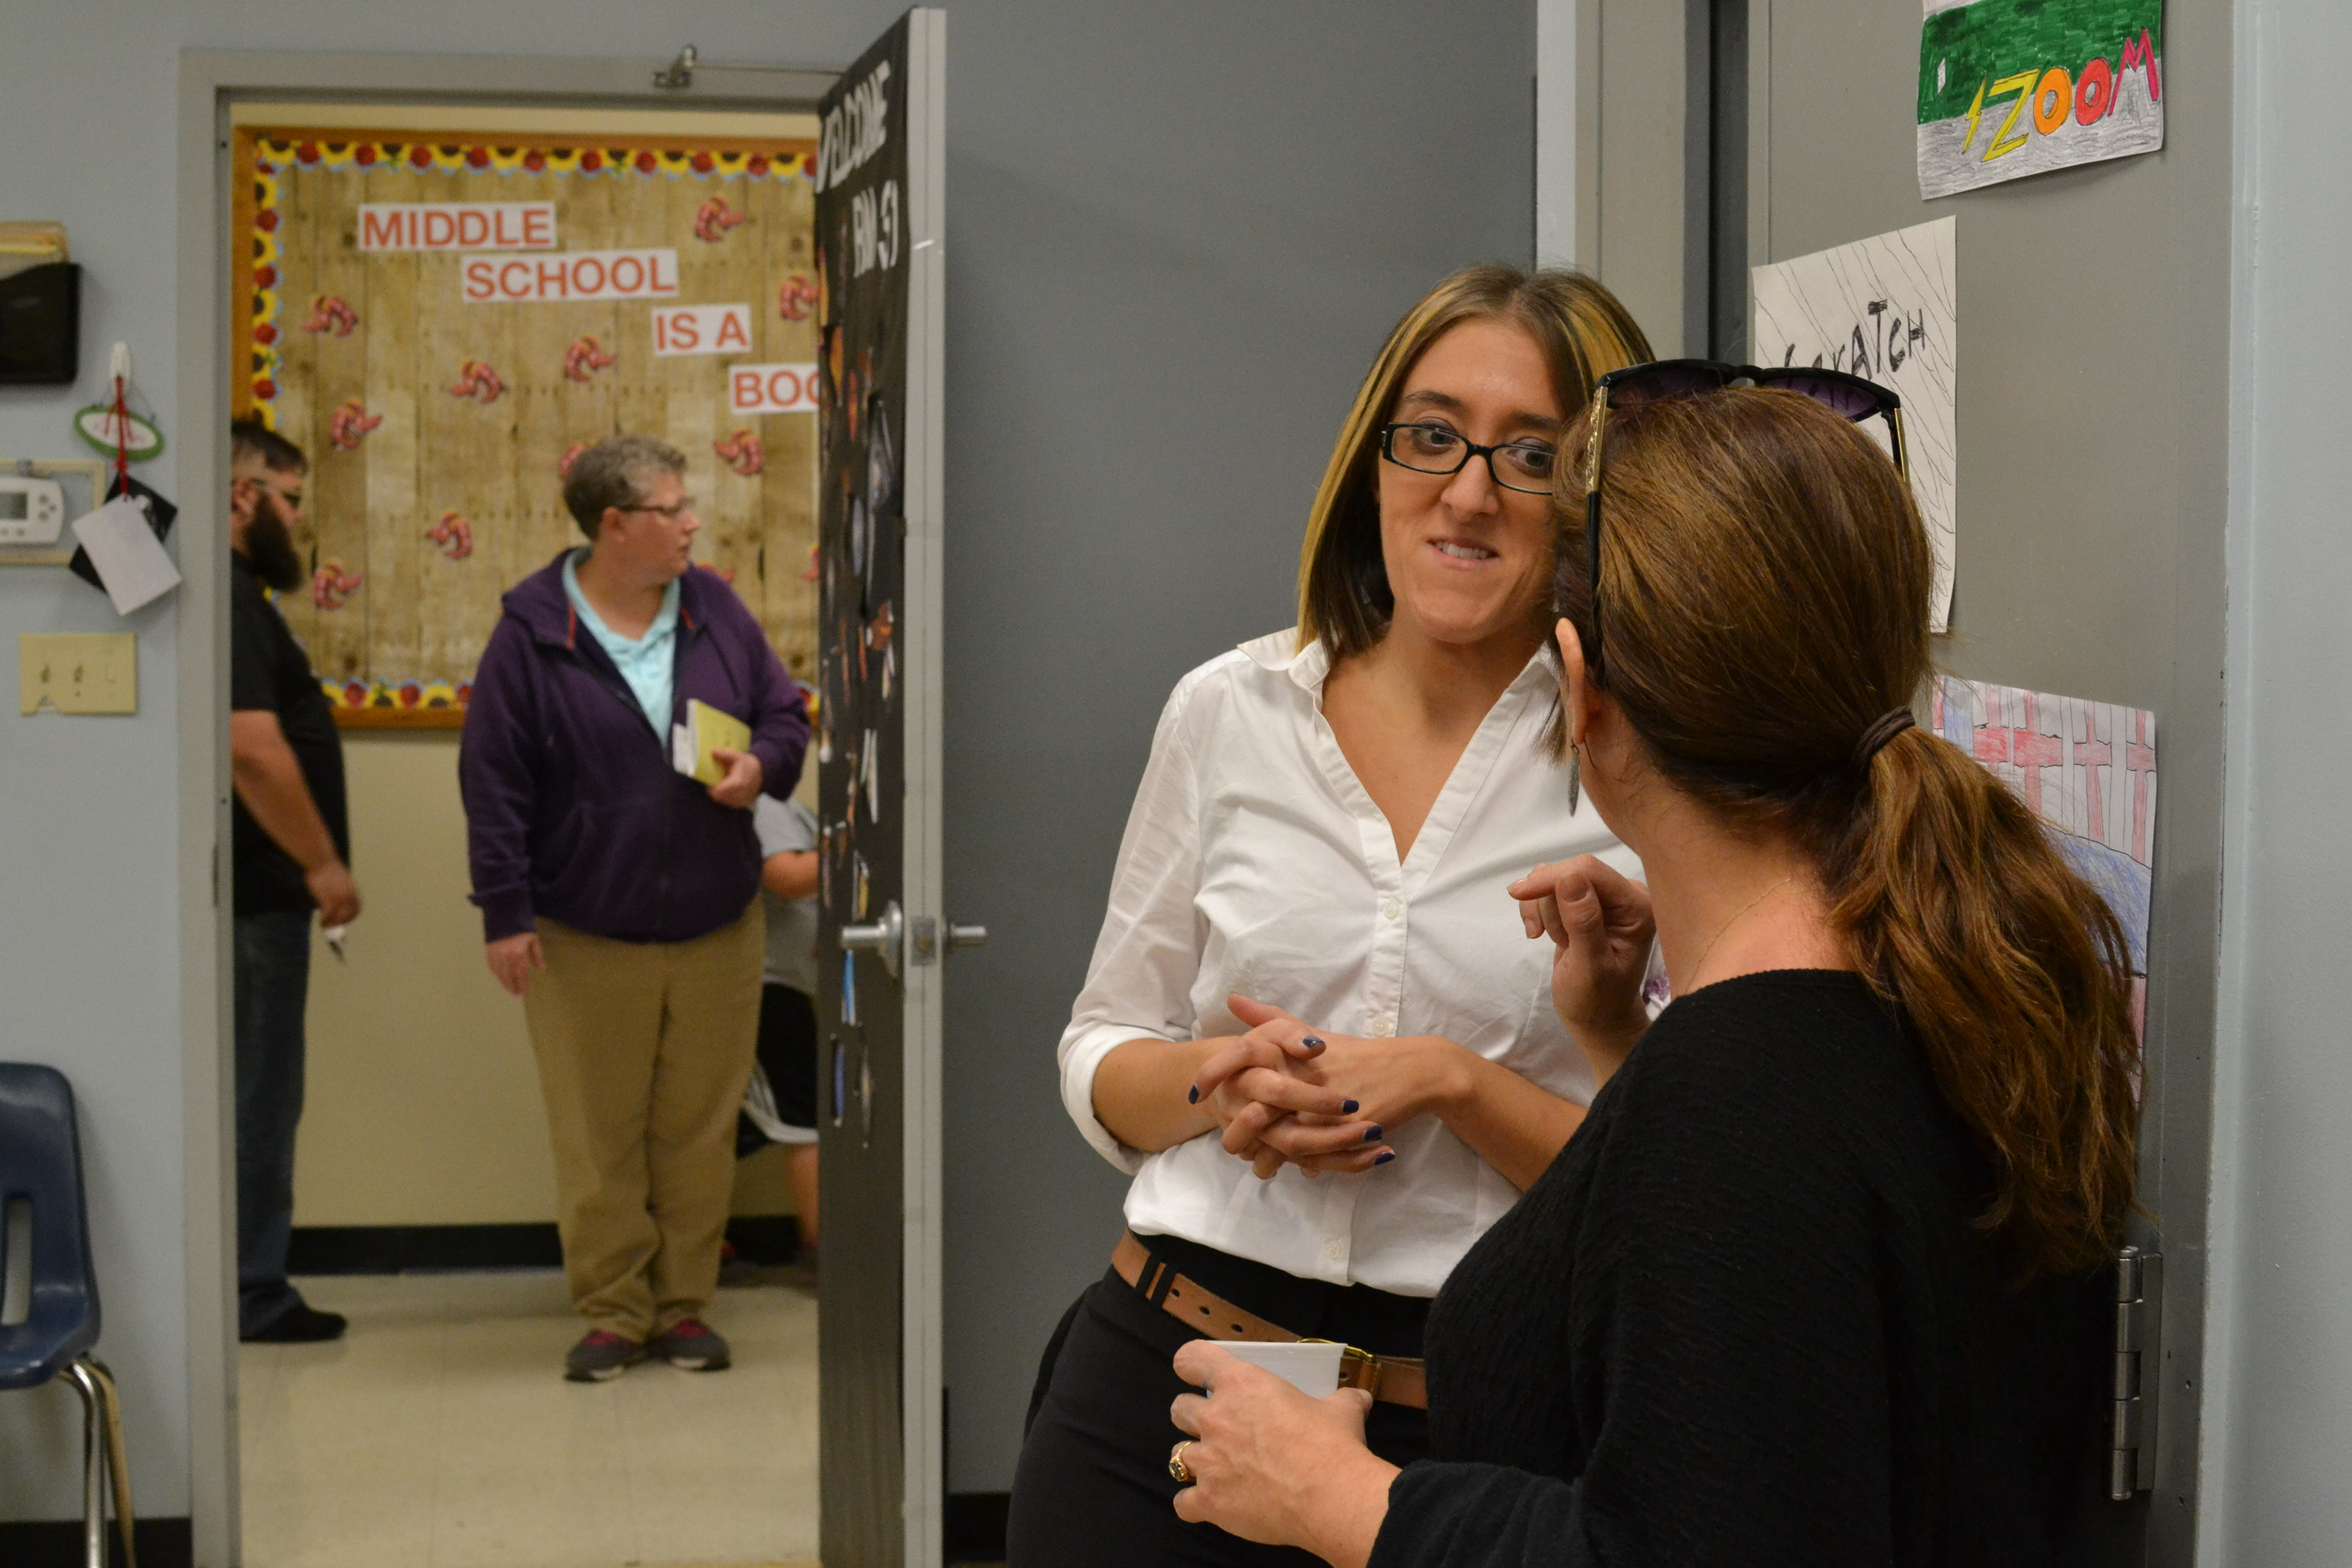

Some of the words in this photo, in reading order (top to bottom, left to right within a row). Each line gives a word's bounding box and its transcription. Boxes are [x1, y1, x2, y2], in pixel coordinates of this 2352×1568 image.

[362, 209, 550, 247] MIDDLE
[466, 256, 675, 296] SCHOOL
[656, 312, 700, 350] IS
[716, 312, 747, 347] A
